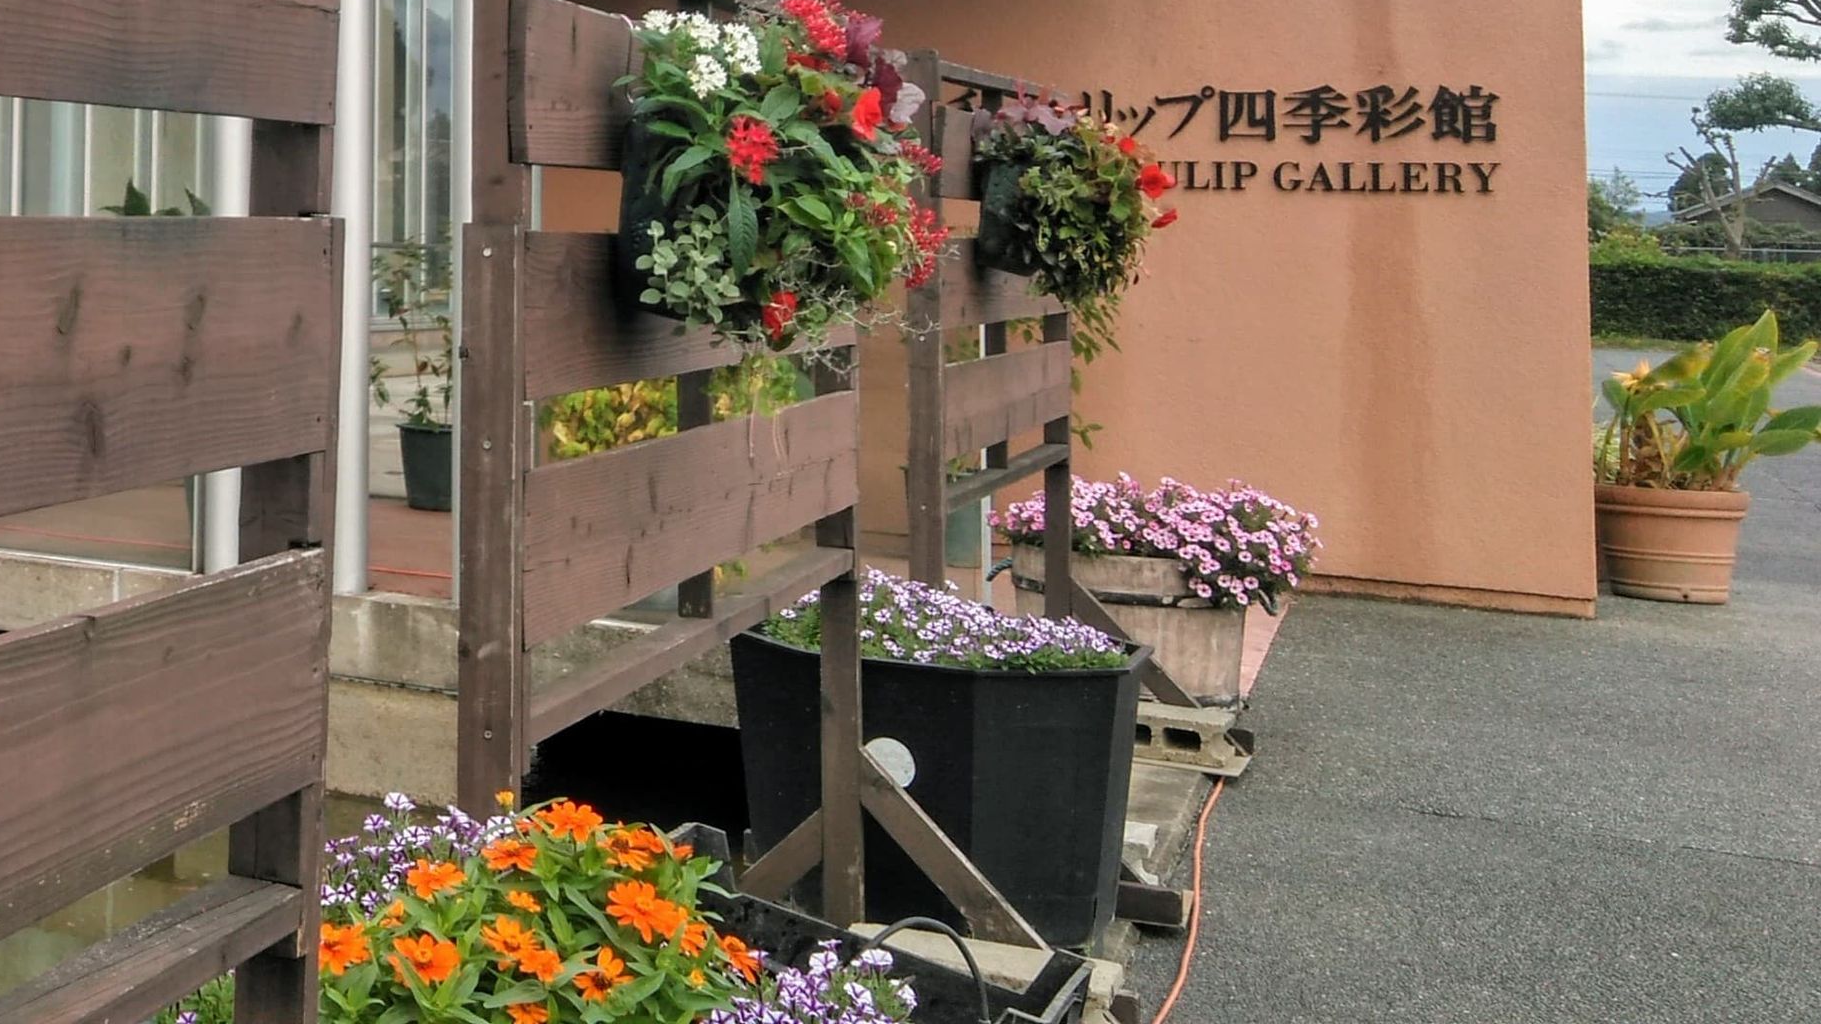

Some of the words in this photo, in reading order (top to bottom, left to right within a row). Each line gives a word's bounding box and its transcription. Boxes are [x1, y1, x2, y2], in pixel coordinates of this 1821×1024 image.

[947, 84, 1500, 144] リップ四季彩館
[1156, 160, 1259, 191] ULIP
[1273, 160, 1501, 193] GALLERY
